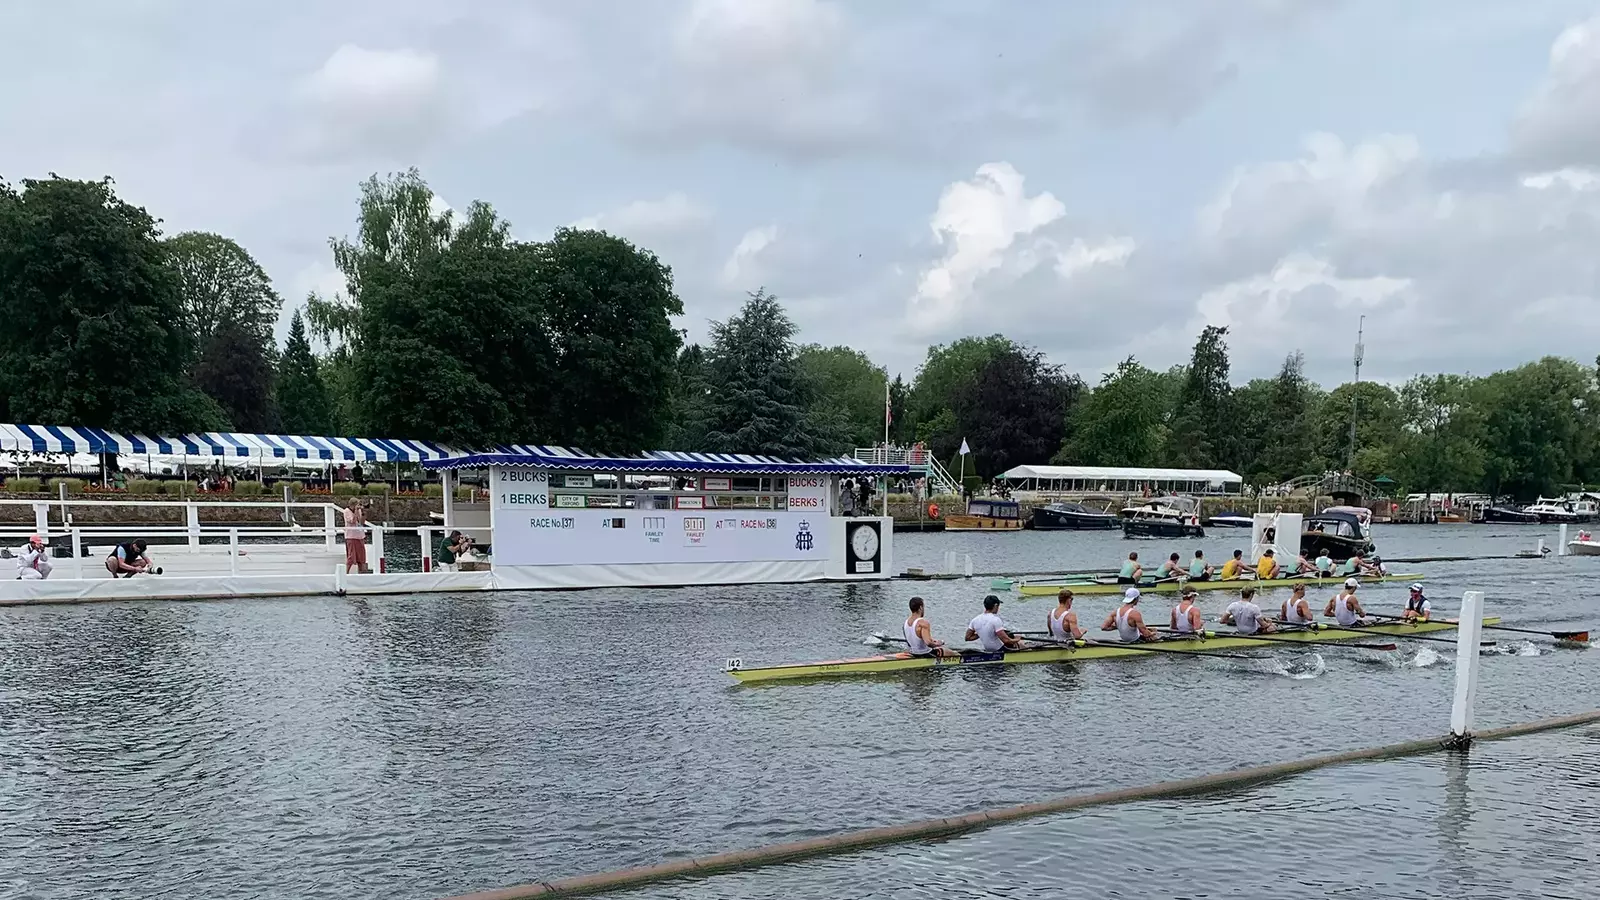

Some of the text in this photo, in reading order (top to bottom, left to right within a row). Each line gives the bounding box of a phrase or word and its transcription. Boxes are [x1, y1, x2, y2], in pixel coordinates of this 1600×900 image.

[501, 471, 546, 482] 2 BUCKS
[790, 478, 824, 487] BUCKS 2
[502, 494, 546, 504] 1 BERKS
[790, 498, 824, 507] BERKS 1
[530, 518, 550, 528] RACE
[602, 519, 610, 528] AT
[716, 520, 723, 528] AT
[740, 520, 756, 528] RACE
